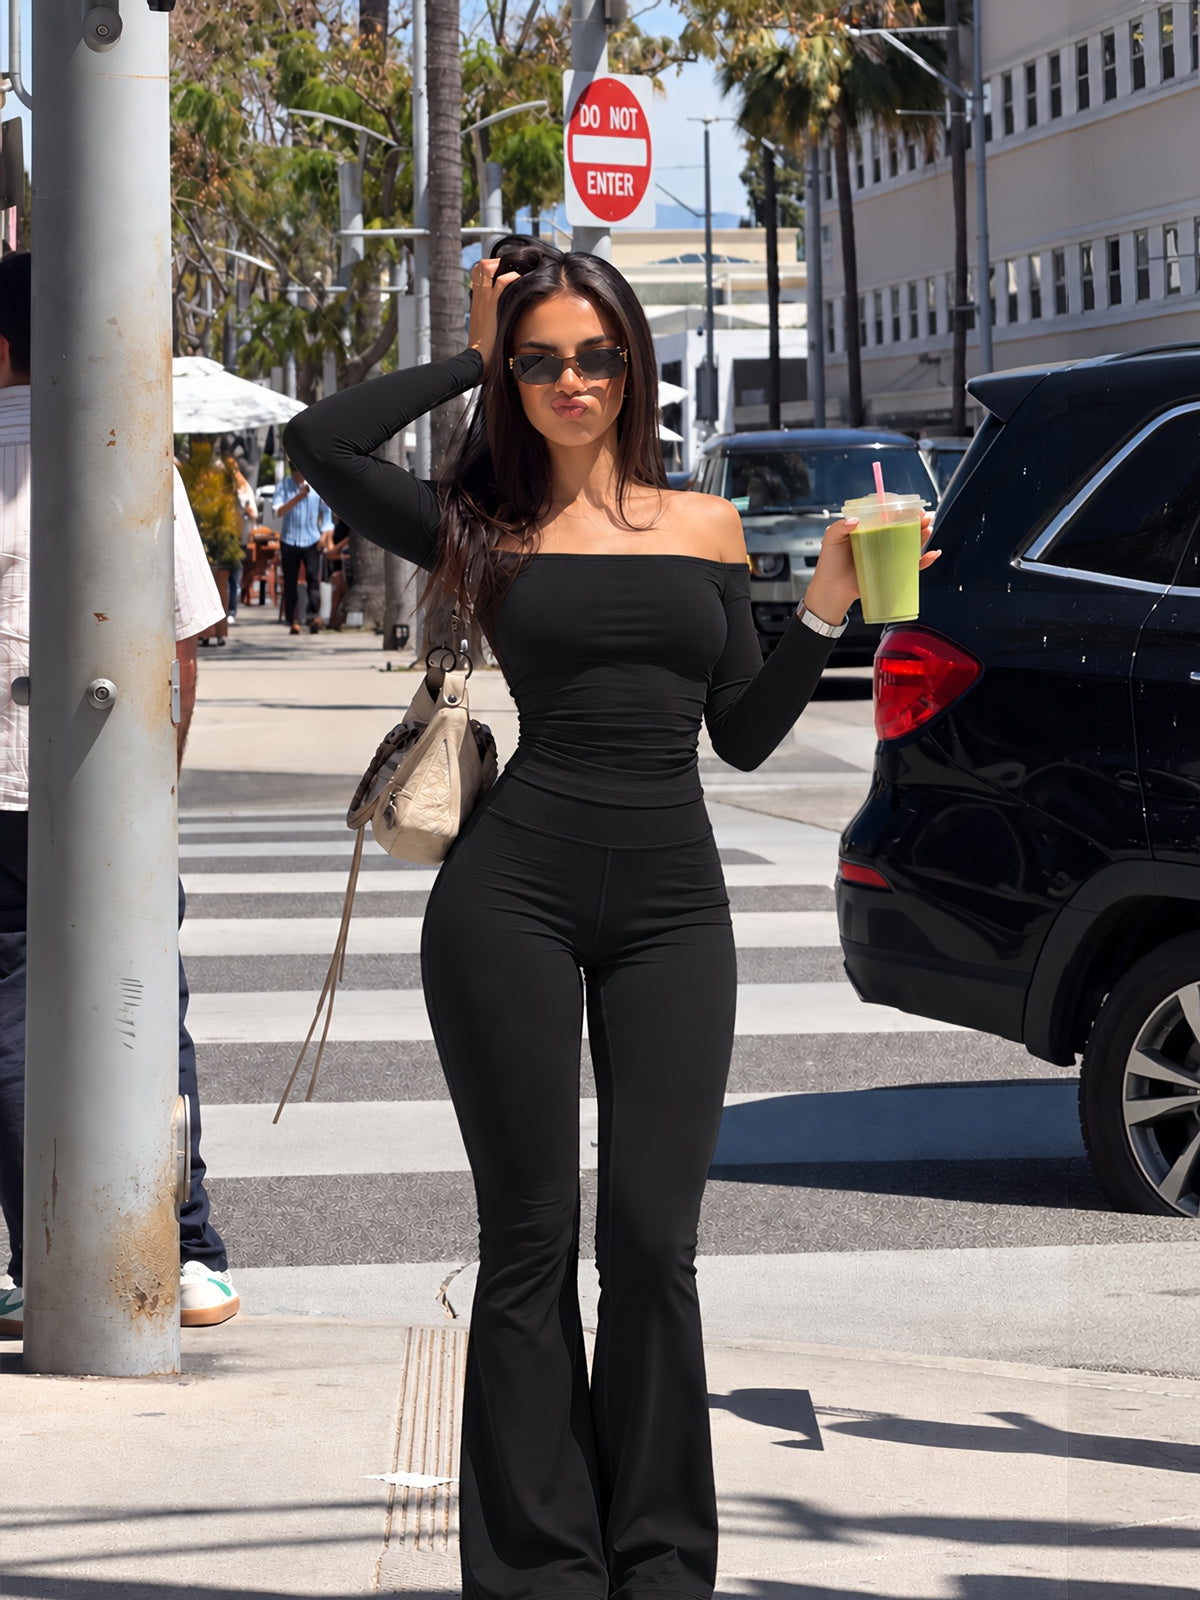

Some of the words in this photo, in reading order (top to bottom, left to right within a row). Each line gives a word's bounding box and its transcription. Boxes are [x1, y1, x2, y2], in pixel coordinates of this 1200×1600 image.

[580, 104, 600, 128] DO
[609, 106, 638, 131] NOT
[586, 170, 634, 197] ENTER
